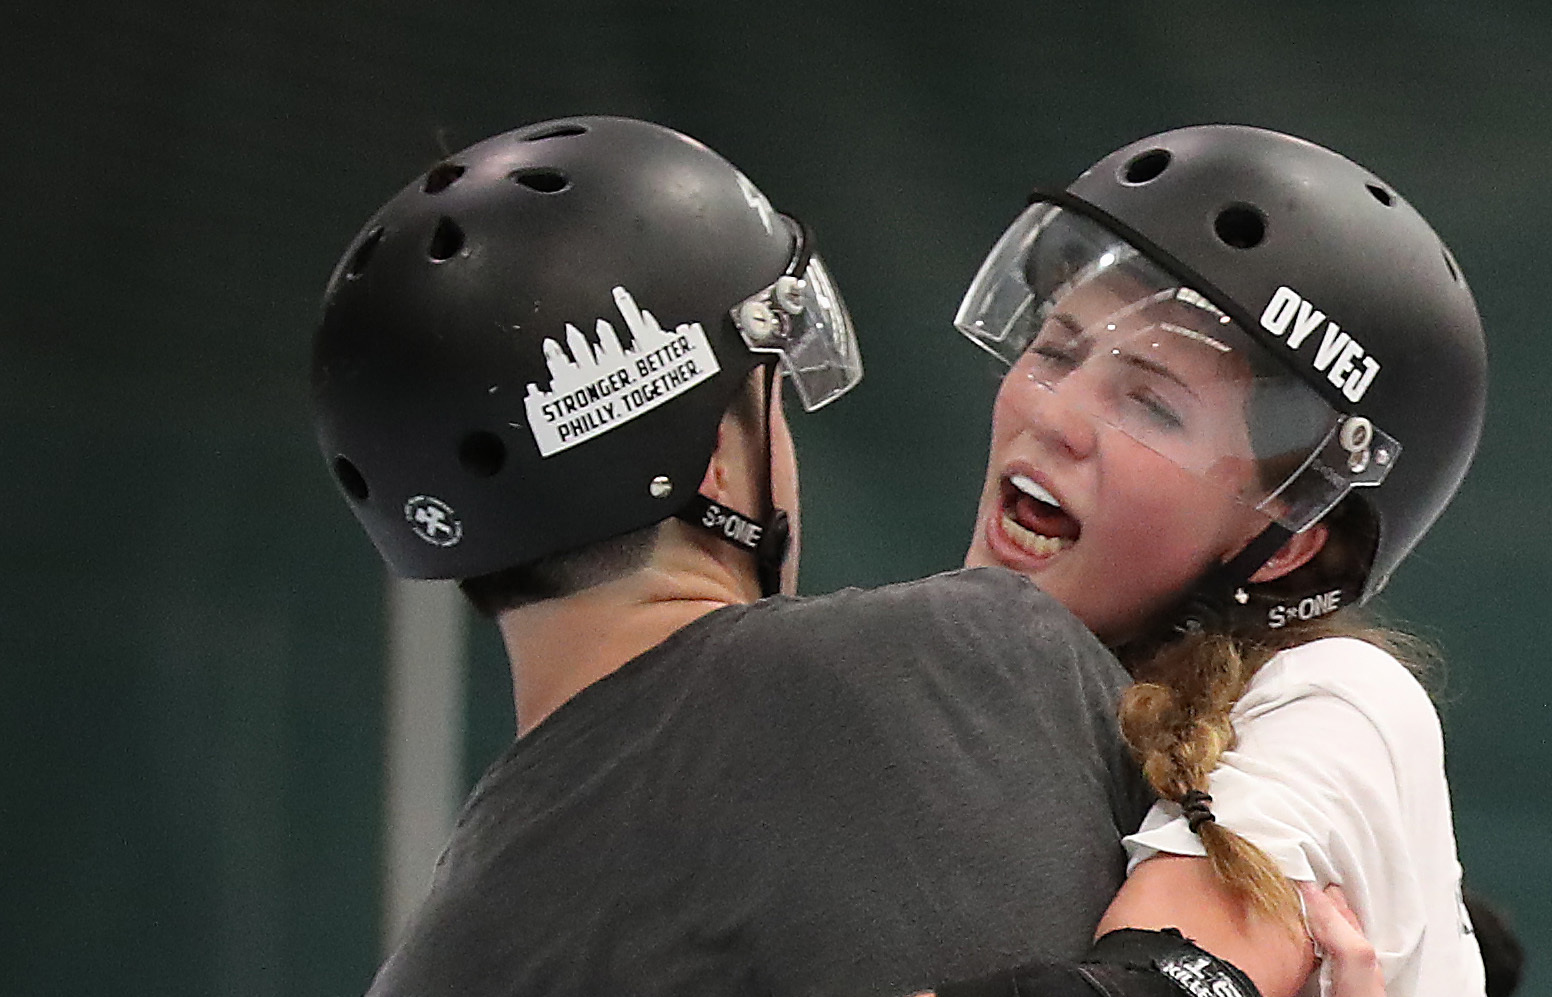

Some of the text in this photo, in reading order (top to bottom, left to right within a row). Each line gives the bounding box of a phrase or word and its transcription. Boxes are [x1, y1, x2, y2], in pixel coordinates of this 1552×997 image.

[542, 335, 697, 422] STRONGER. BETTER.
[1260, 286, 1381, 402] OY VEJ
[558, 402, 623, 441] PHILLY.
